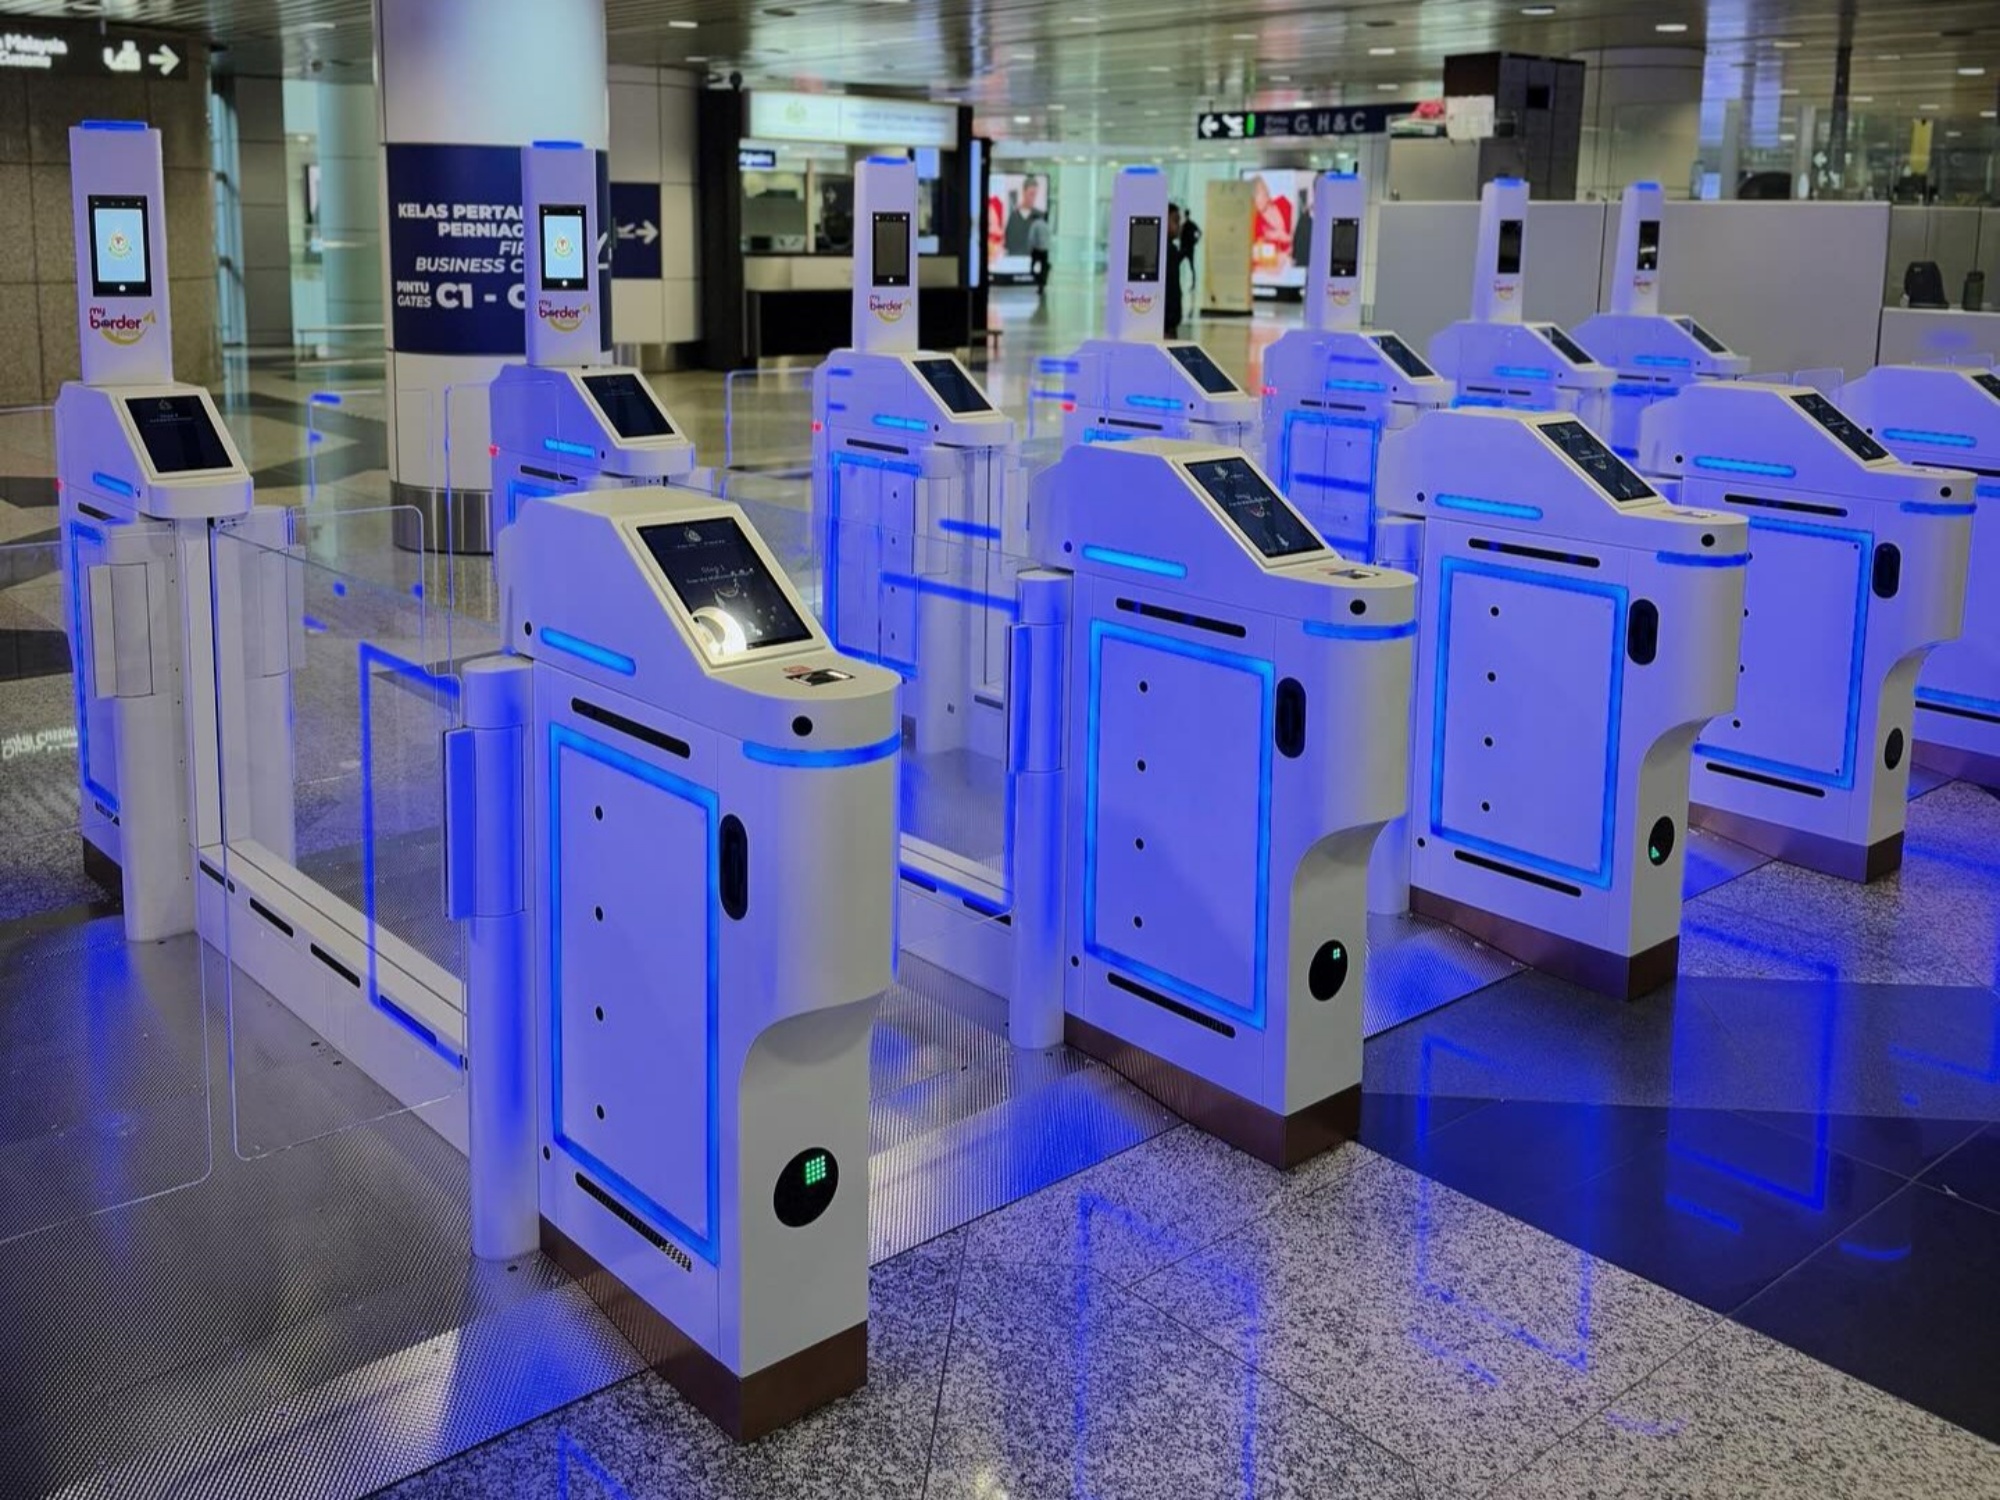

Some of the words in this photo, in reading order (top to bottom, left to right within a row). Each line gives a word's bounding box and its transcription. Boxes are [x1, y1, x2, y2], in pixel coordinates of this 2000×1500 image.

[1316, 112, 1331, 132] H
[1333, 112, 1347, 132] &
[1350, 111, 1366, 131] C
[398, 203, 449, 219] KELAS
[415, 257, 506, 274] BUSINESS
[396, 281, 430, 294] PINTU
[396, 295, 432, 308] GATES
[435, 282, 474, 310] C1
[89, 306, 106, 318] my
[538, 305, 580, 319] border
[89, 313, 142, 330] border
